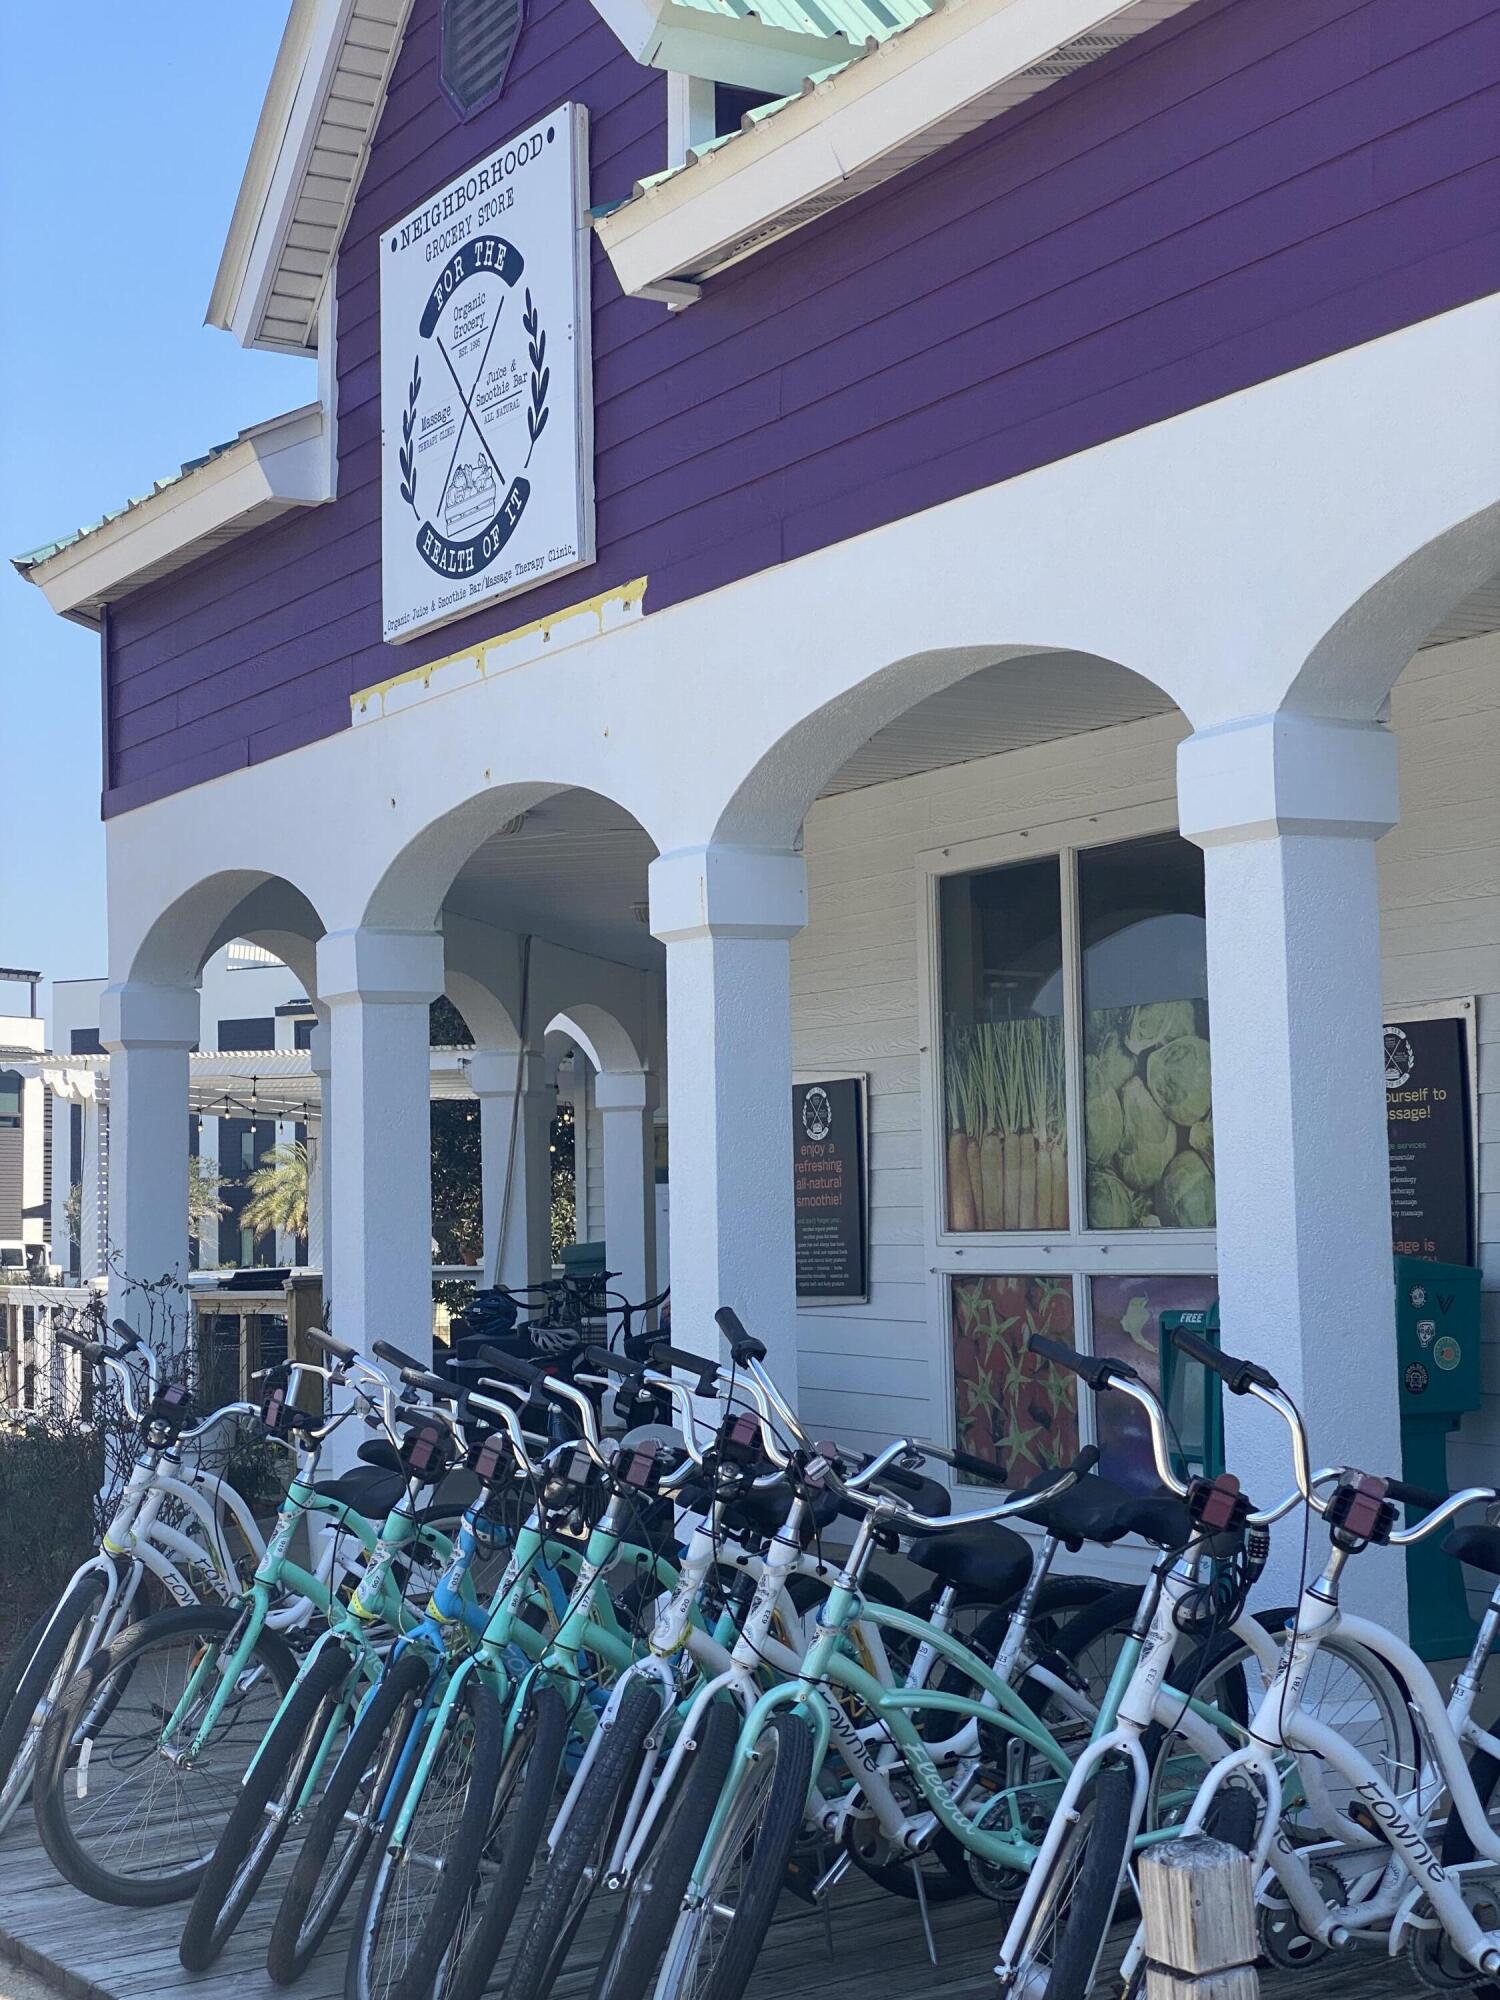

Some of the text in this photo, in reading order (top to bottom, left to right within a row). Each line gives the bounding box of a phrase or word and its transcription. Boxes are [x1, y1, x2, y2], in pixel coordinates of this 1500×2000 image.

[400, 133, 543, 250] NEIGHBORHOOD
[425, 186, 514, 262] GROCERY STORE
[434, 240, 507, 312] FOR THE
[453, 292, 486, 321] Organic
[453, 312, 486, 340] Grocery
[486, 359, 516, 386] Juice &
[475, 371, 528, 407] Smoothie Bar
[421, 405, 451, 432] Massage
[483, 399, 521, 424] ALL NATURAL
[422, 488, 522, 573] HEALTH OF IT
[387, 613, 410, 631] Organic
[412, 605, 429, 621] Juice
[430, 600, 436, 612] &
[438, 588, 466, 608] Smoothie
[514, 556, 545, 577] Therapy
[1386, 1087, 1447, 1103] ourself to
[1387, 1105, 1431, 1121] ssage!
[800, 1143, 835, 1157] enjoy a
[795, 1158, 842, 1173] refreshing
[796, 1175, 842, 1190] all-natural
[796, 1192, 842, 1207] smoothie!
[1392, 1238, 1436, 1254] sage is
[1180, 1312, 1204, 1323] FREE
[371, 1575, 381, 1589] 607
[581, 1594, 591, 1608] 177
[680, 1598, 690, 1613] 620
[761, 1609, 771, 1625] 623
[919, 1646, 929, 1655] 20
[999, 1655, 1008, 1664] 23
[1144, 1668, 1158, 1686] 733
[1290, 1676, 1303, 1692] 781
[1355, 1781, 1446, 1883] townie
